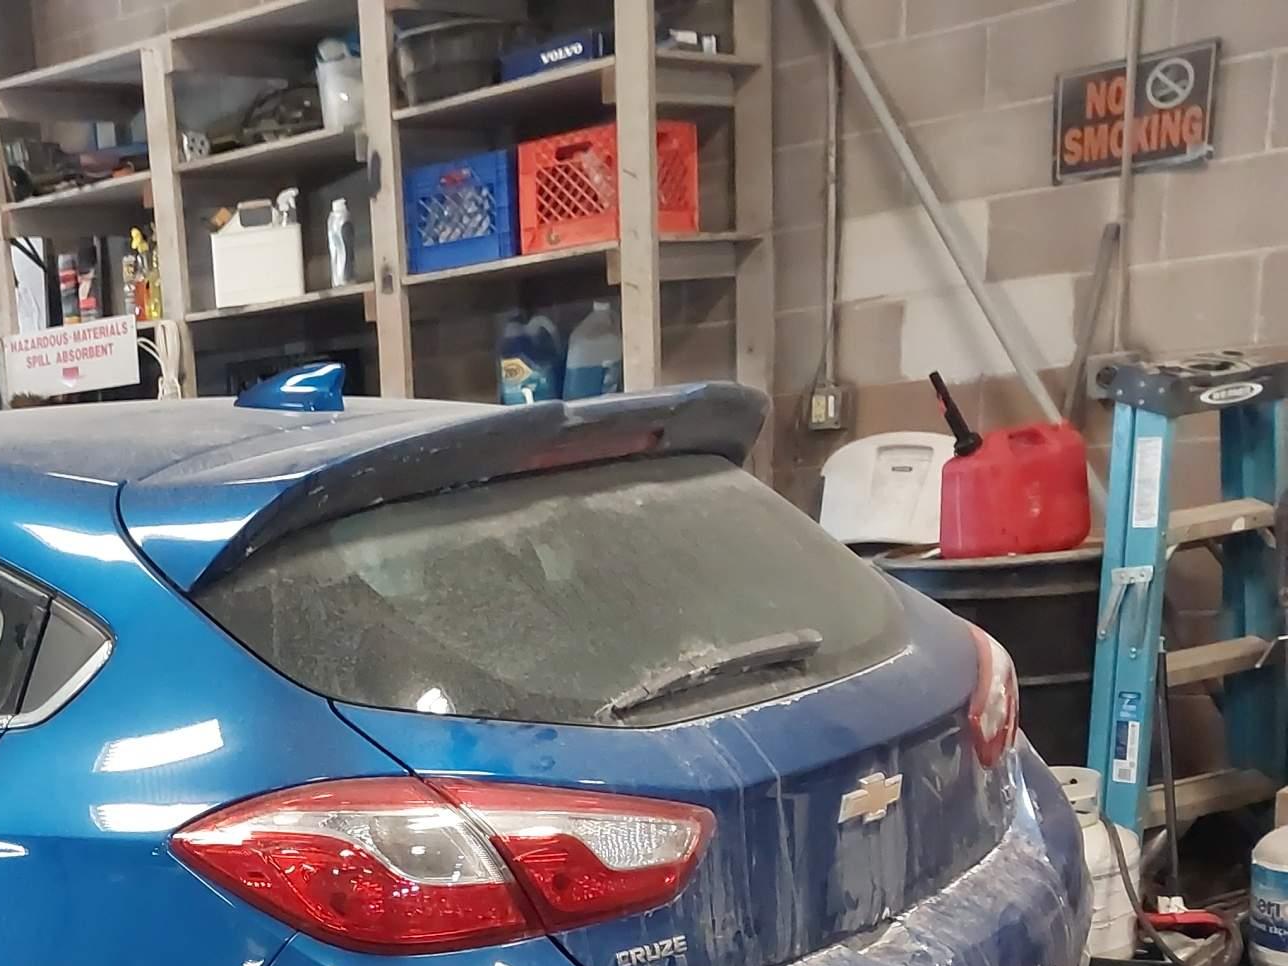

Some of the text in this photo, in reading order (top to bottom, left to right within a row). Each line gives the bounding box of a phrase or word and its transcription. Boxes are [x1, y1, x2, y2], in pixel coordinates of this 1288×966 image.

[540, 42, 583, 64] VOLVO
[1085, 76, 1127, 120] NO
[1064, 104, 1203, 166] SMOKING
[10, 321, 129, 353] HAZARDOUS MATERIALS
[26, 343, 114, 369] SPILL ABSORBENT
